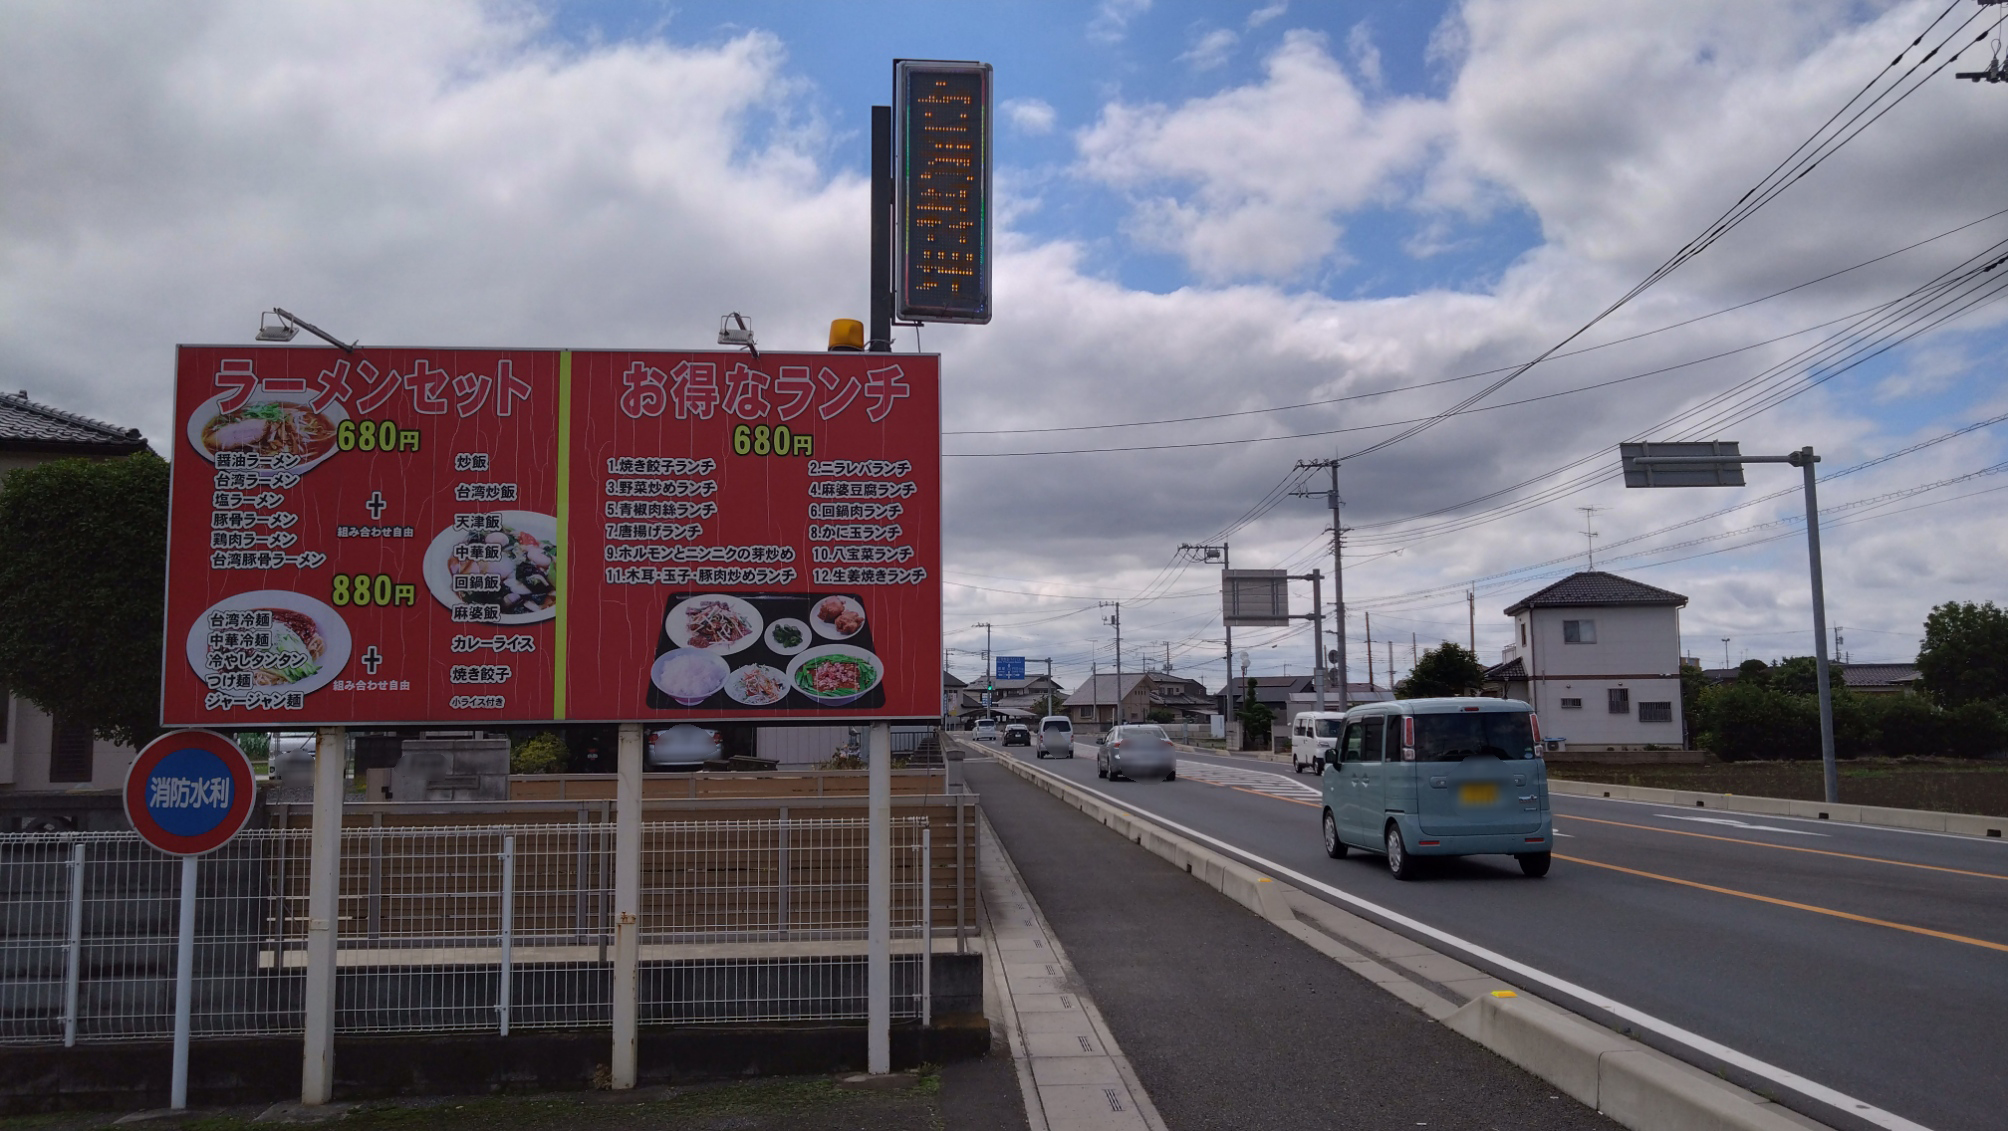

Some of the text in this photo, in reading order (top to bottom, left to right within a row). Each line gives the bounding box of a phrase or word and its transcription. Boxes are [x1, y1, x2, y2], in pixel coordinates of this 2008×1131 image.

[214, 358, 533, 418] ラーメンセット
[620, 360, 910, 422] お得なランチ
[337, 419, 421, 453] 680円
[733, 424, 814, 457] 680円
[215, 452, 300, 469] 醤油ラーメン
[455, 454, 488, 470] 炒飯
[607, 458, 715, 474] 1.焼き餃子ランチ
[809, 461, 911, 477] 2.ニラレバランチ
[215, 472, 299, 488] 台湾ラーメン
[606, 480, 717, 496] 3.野菜炒めランチ
[455, 484, 516, 500] 台湾炒飯
[809, 482, 916, 498] 4.麻婆豆腐ランチ
[214, 492, 283, 508] 塩ラーメン
[809, 504, 903, 519] 6.回鍋肉ランチ
[212, 512, 297, 528] 豚骨ラーメン
[455, 514, 501, 530] 天津飯
[337, 526, 414, 539] 組み合わせ自由
[606, 523, 702, 539] 7.唐揚げランチ
[809, 525, 902, 541] 8.かに玉ランチ
[212, 531, 296, 548] 鶏肉ラーメン
[211, 551, 325, 568] 台湾豚骨ラーメン
[454, 544, 500, 560] 中華飯
[812, 547, 913, 562] 10.八宝菜ランチ
[454, 574, 500, 591] 回鍋飯
[813, 568, 926, 584] 12.生姜焼きランチ
[332, 573, 416, 607] 880円
[209, 612, 271, 628] 台湾冷麺
[452, 605, 499, 621] 麻婆飯
[209, 632, 270, 648] 中華冷麺
[452, 635, 535, 651] カレーライス
[207, 652, 306, 669] 冷やしタンタン
[206, 672, 252, 689] つけ麺
[451, 666, 511, 682] 焼き餃子
[332, 679, 411, 692] 組み合わせ自由
[206, 692, 303, 709] ジャージャン麺
[451, 696, 505, 709] 小ライス付き
[149, 776, 230, 809] 消防水利
